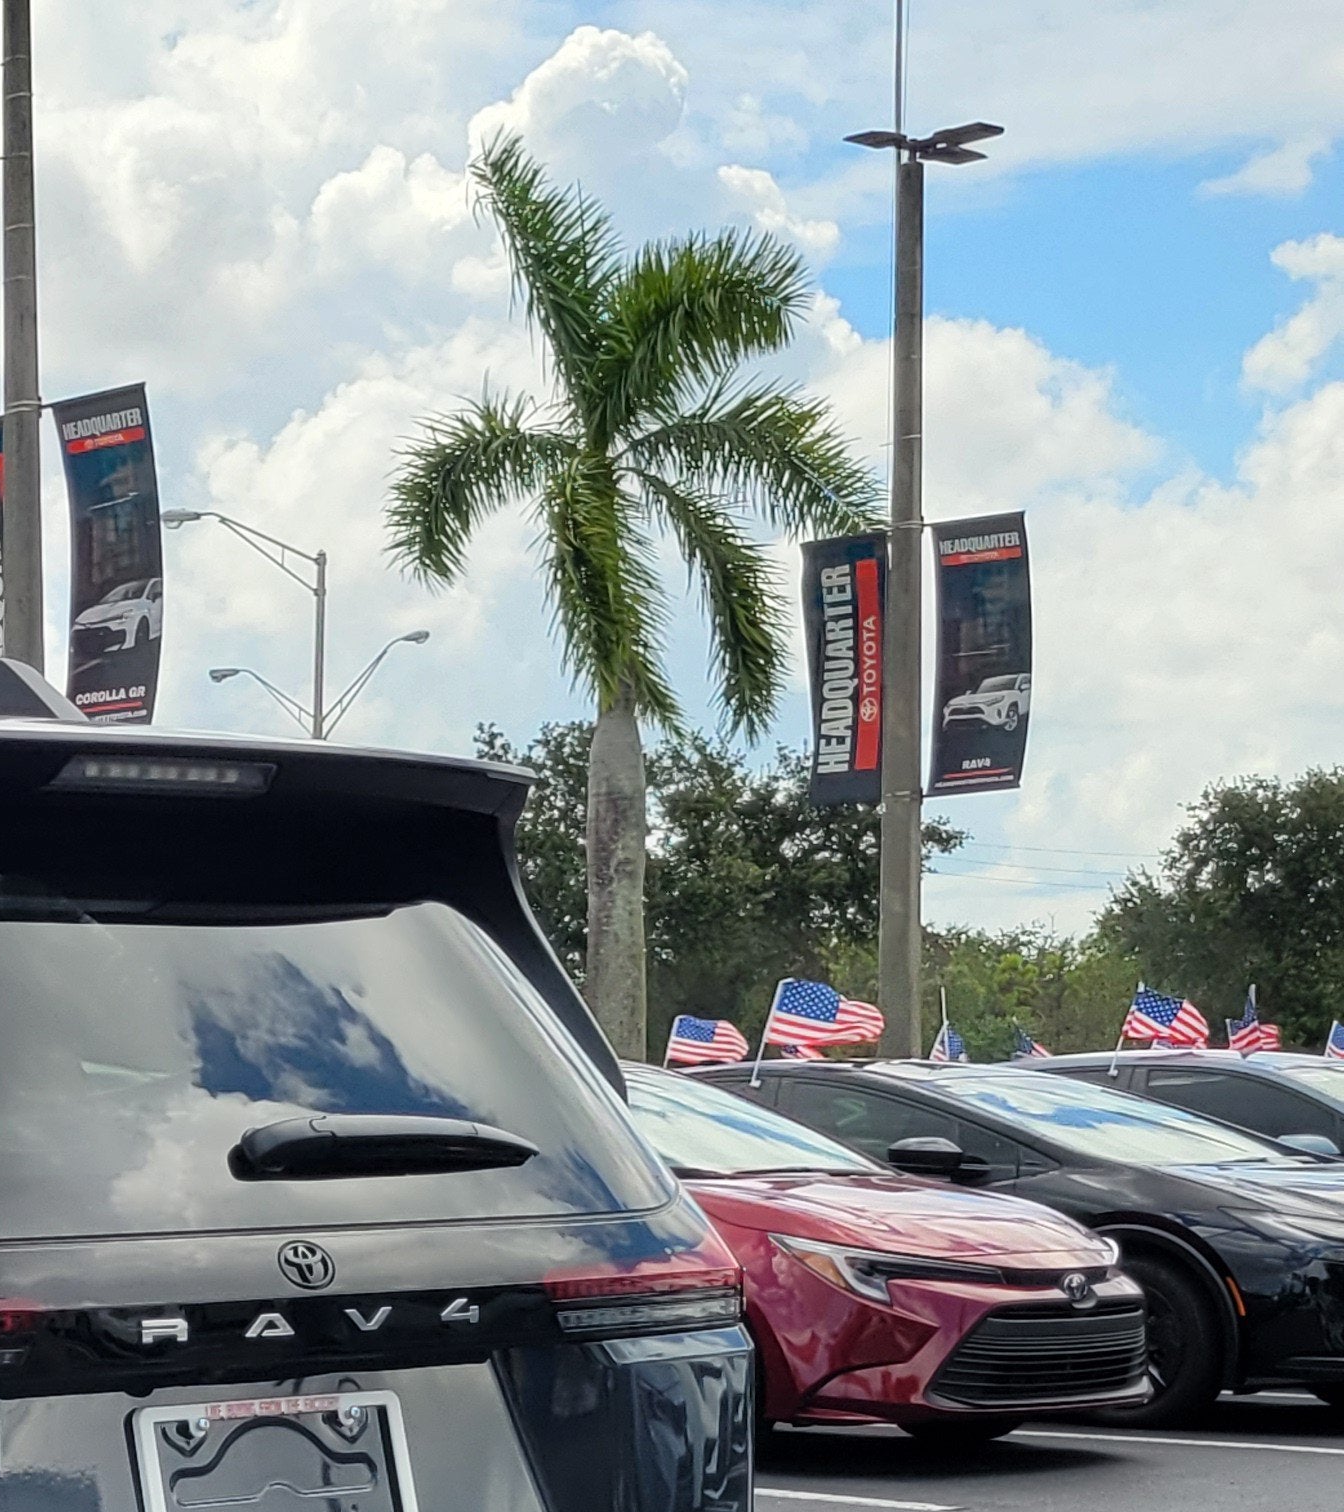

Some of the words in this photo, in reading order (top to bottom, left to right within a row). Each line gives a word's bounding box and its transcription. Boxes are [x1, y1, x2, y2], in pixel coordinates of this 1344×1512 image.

[61, 407, 143, 440] HEADQUARTER
[939, 532, 1020, 555] HEADQUARTER
[817, 563, 858, 774] HEADQUARTER
[864, 616, 878, 693] TOYOTA
[75, 686, 127, 705] COROLLA
[128, 685, 146, 698] GR
[961, 757, 992, 770] RAV4
